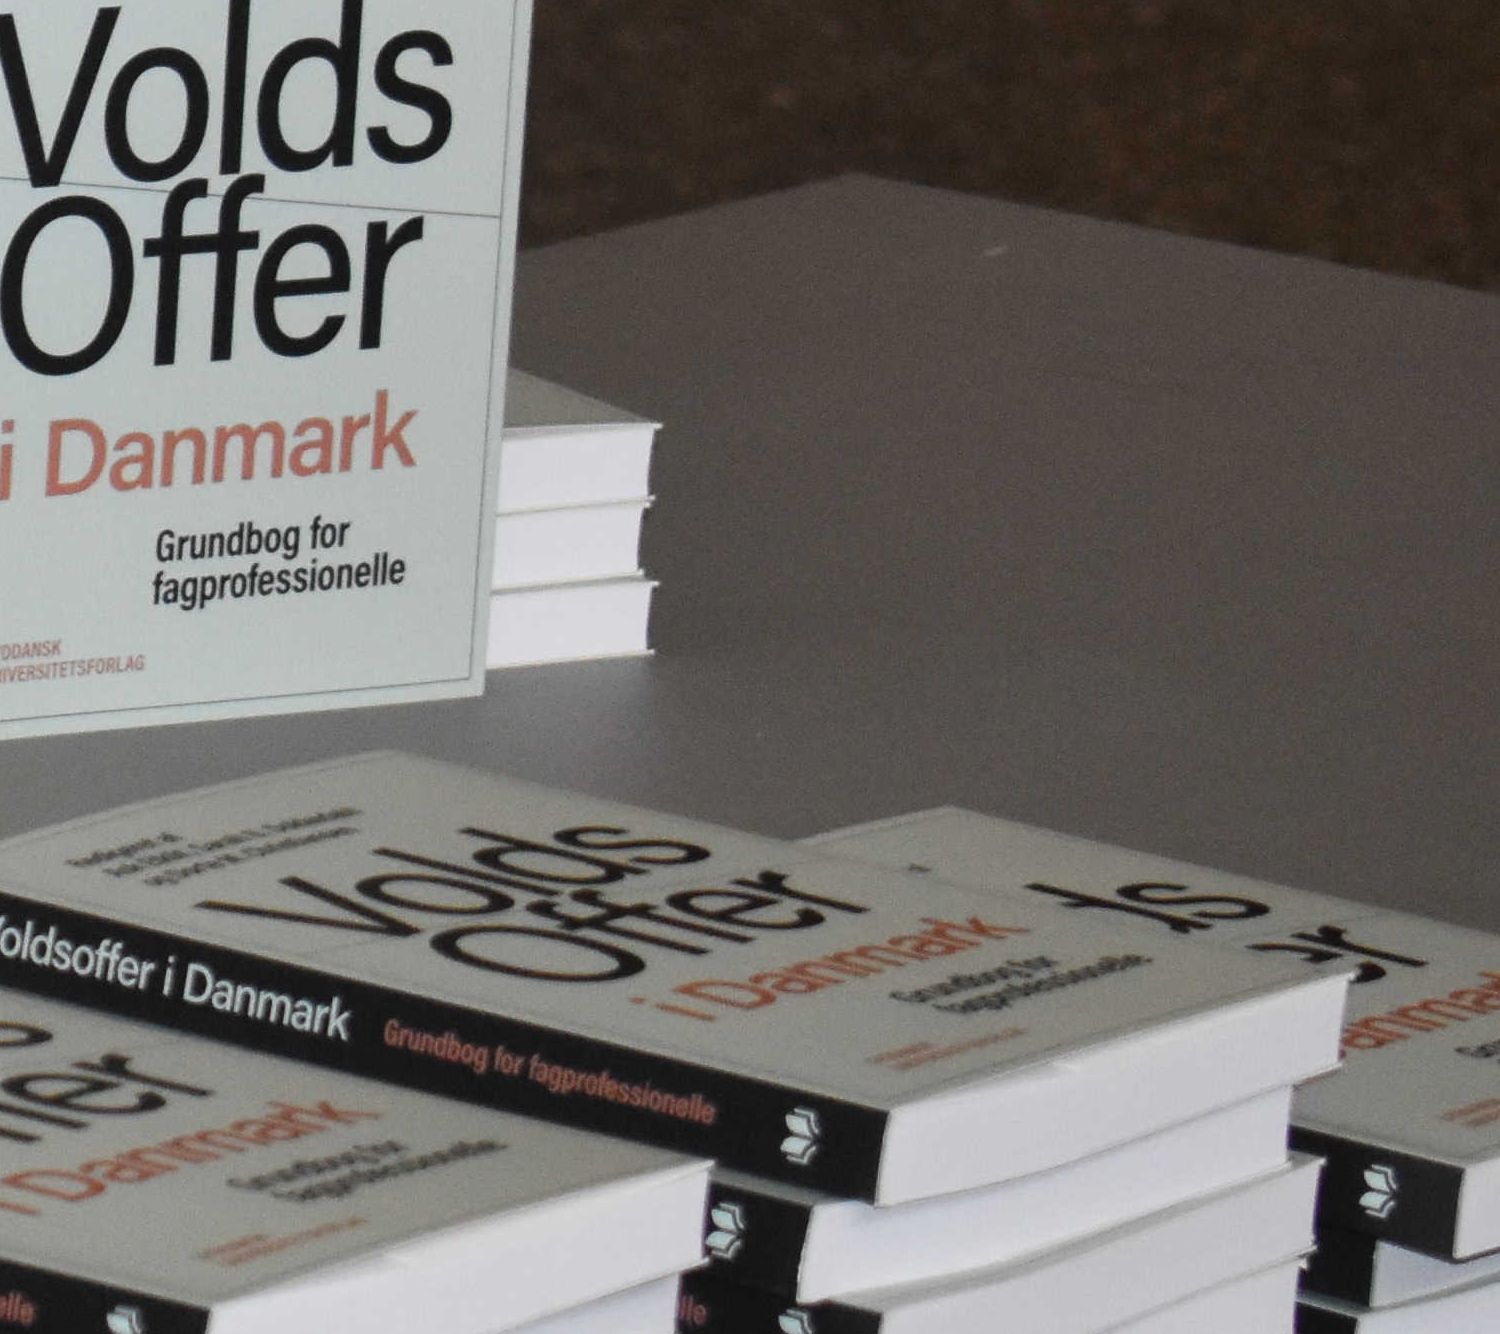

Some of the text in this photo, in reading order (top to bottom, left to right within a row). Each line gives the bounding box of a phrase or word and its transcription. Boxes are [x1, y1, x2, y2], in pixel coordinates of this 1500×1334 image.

[45, 389, 419, 496] Danmark
[152, 551, 406, 611] fagprofessionelle
[156, 514, 351, 563] Grundbog for
[194, 825, 713, 938] Volds
[428, 868, 870, 984] Offer
[163, 954, 174, 998] i
[182, 963, 351, 1042] Danmark
[673, 916, 1031, 1011] Danmark
[383, 1018, 490, 1075] Grundbog
[494, 1046, 525, 1077] for
[0, 1100, 382, 1203] Danmark
